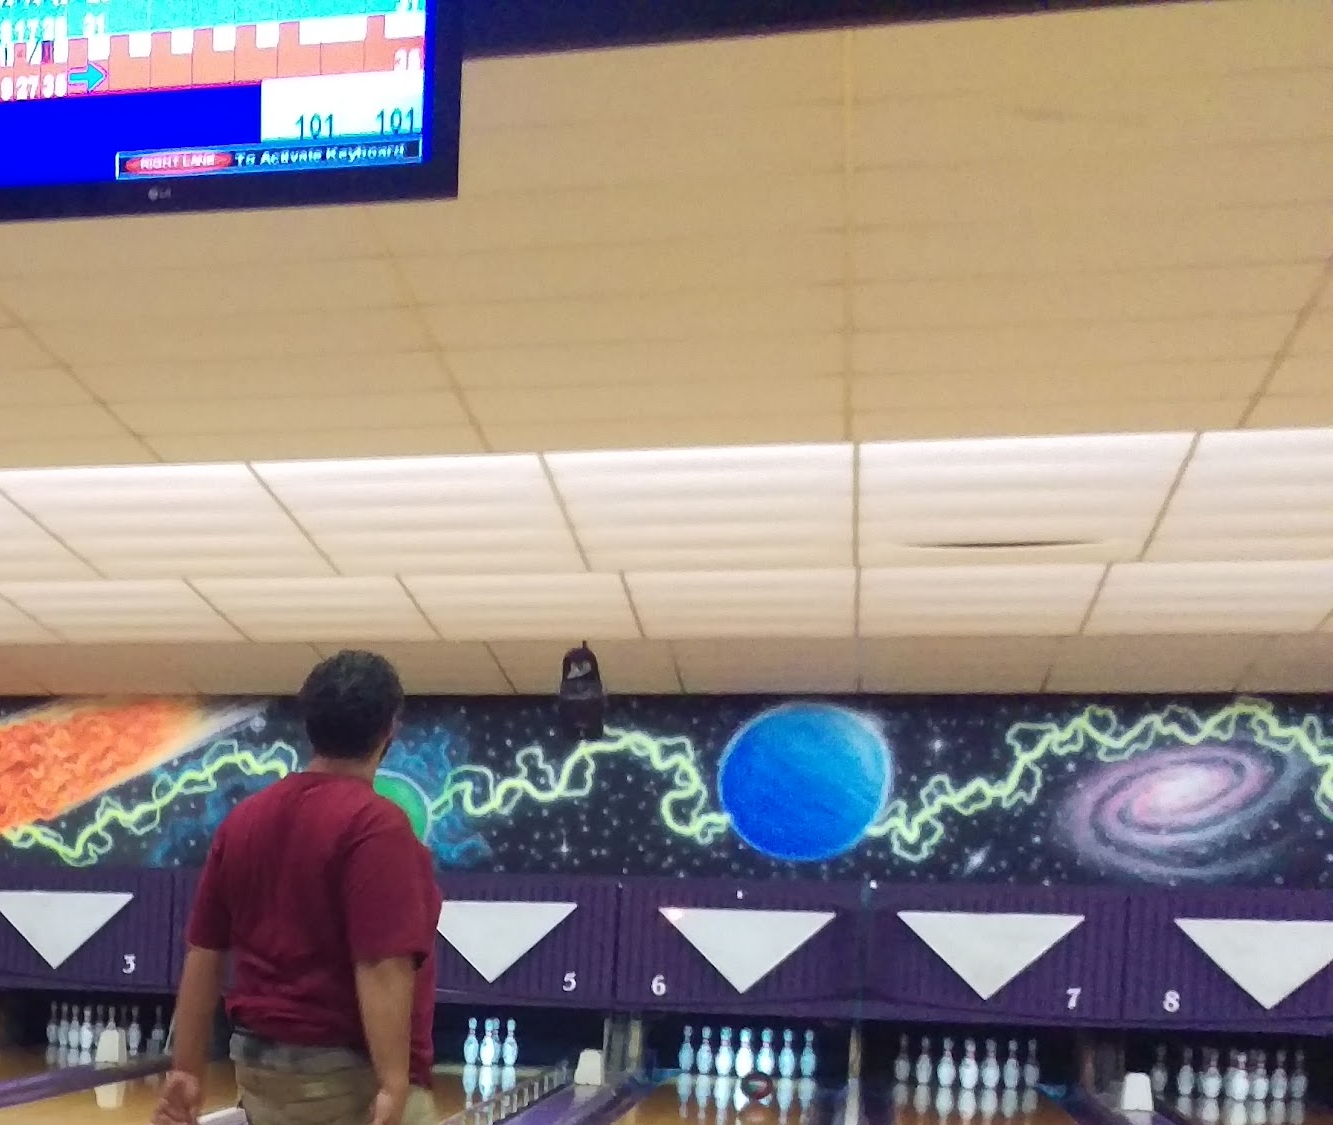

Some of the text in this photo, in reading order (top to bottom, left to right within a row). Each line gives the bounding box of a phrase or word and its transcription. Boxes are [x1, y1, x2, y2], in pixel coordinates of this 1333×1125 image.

[296, 107, 414, 140] 101 101
[122, 954, 136, 975] 3
[563, 972, 577, 993] 5
[651, 975, 666, 997] 6
[1066, 988, 1081, 1010] 7
[1164, 991, 1179, 1013] 8
